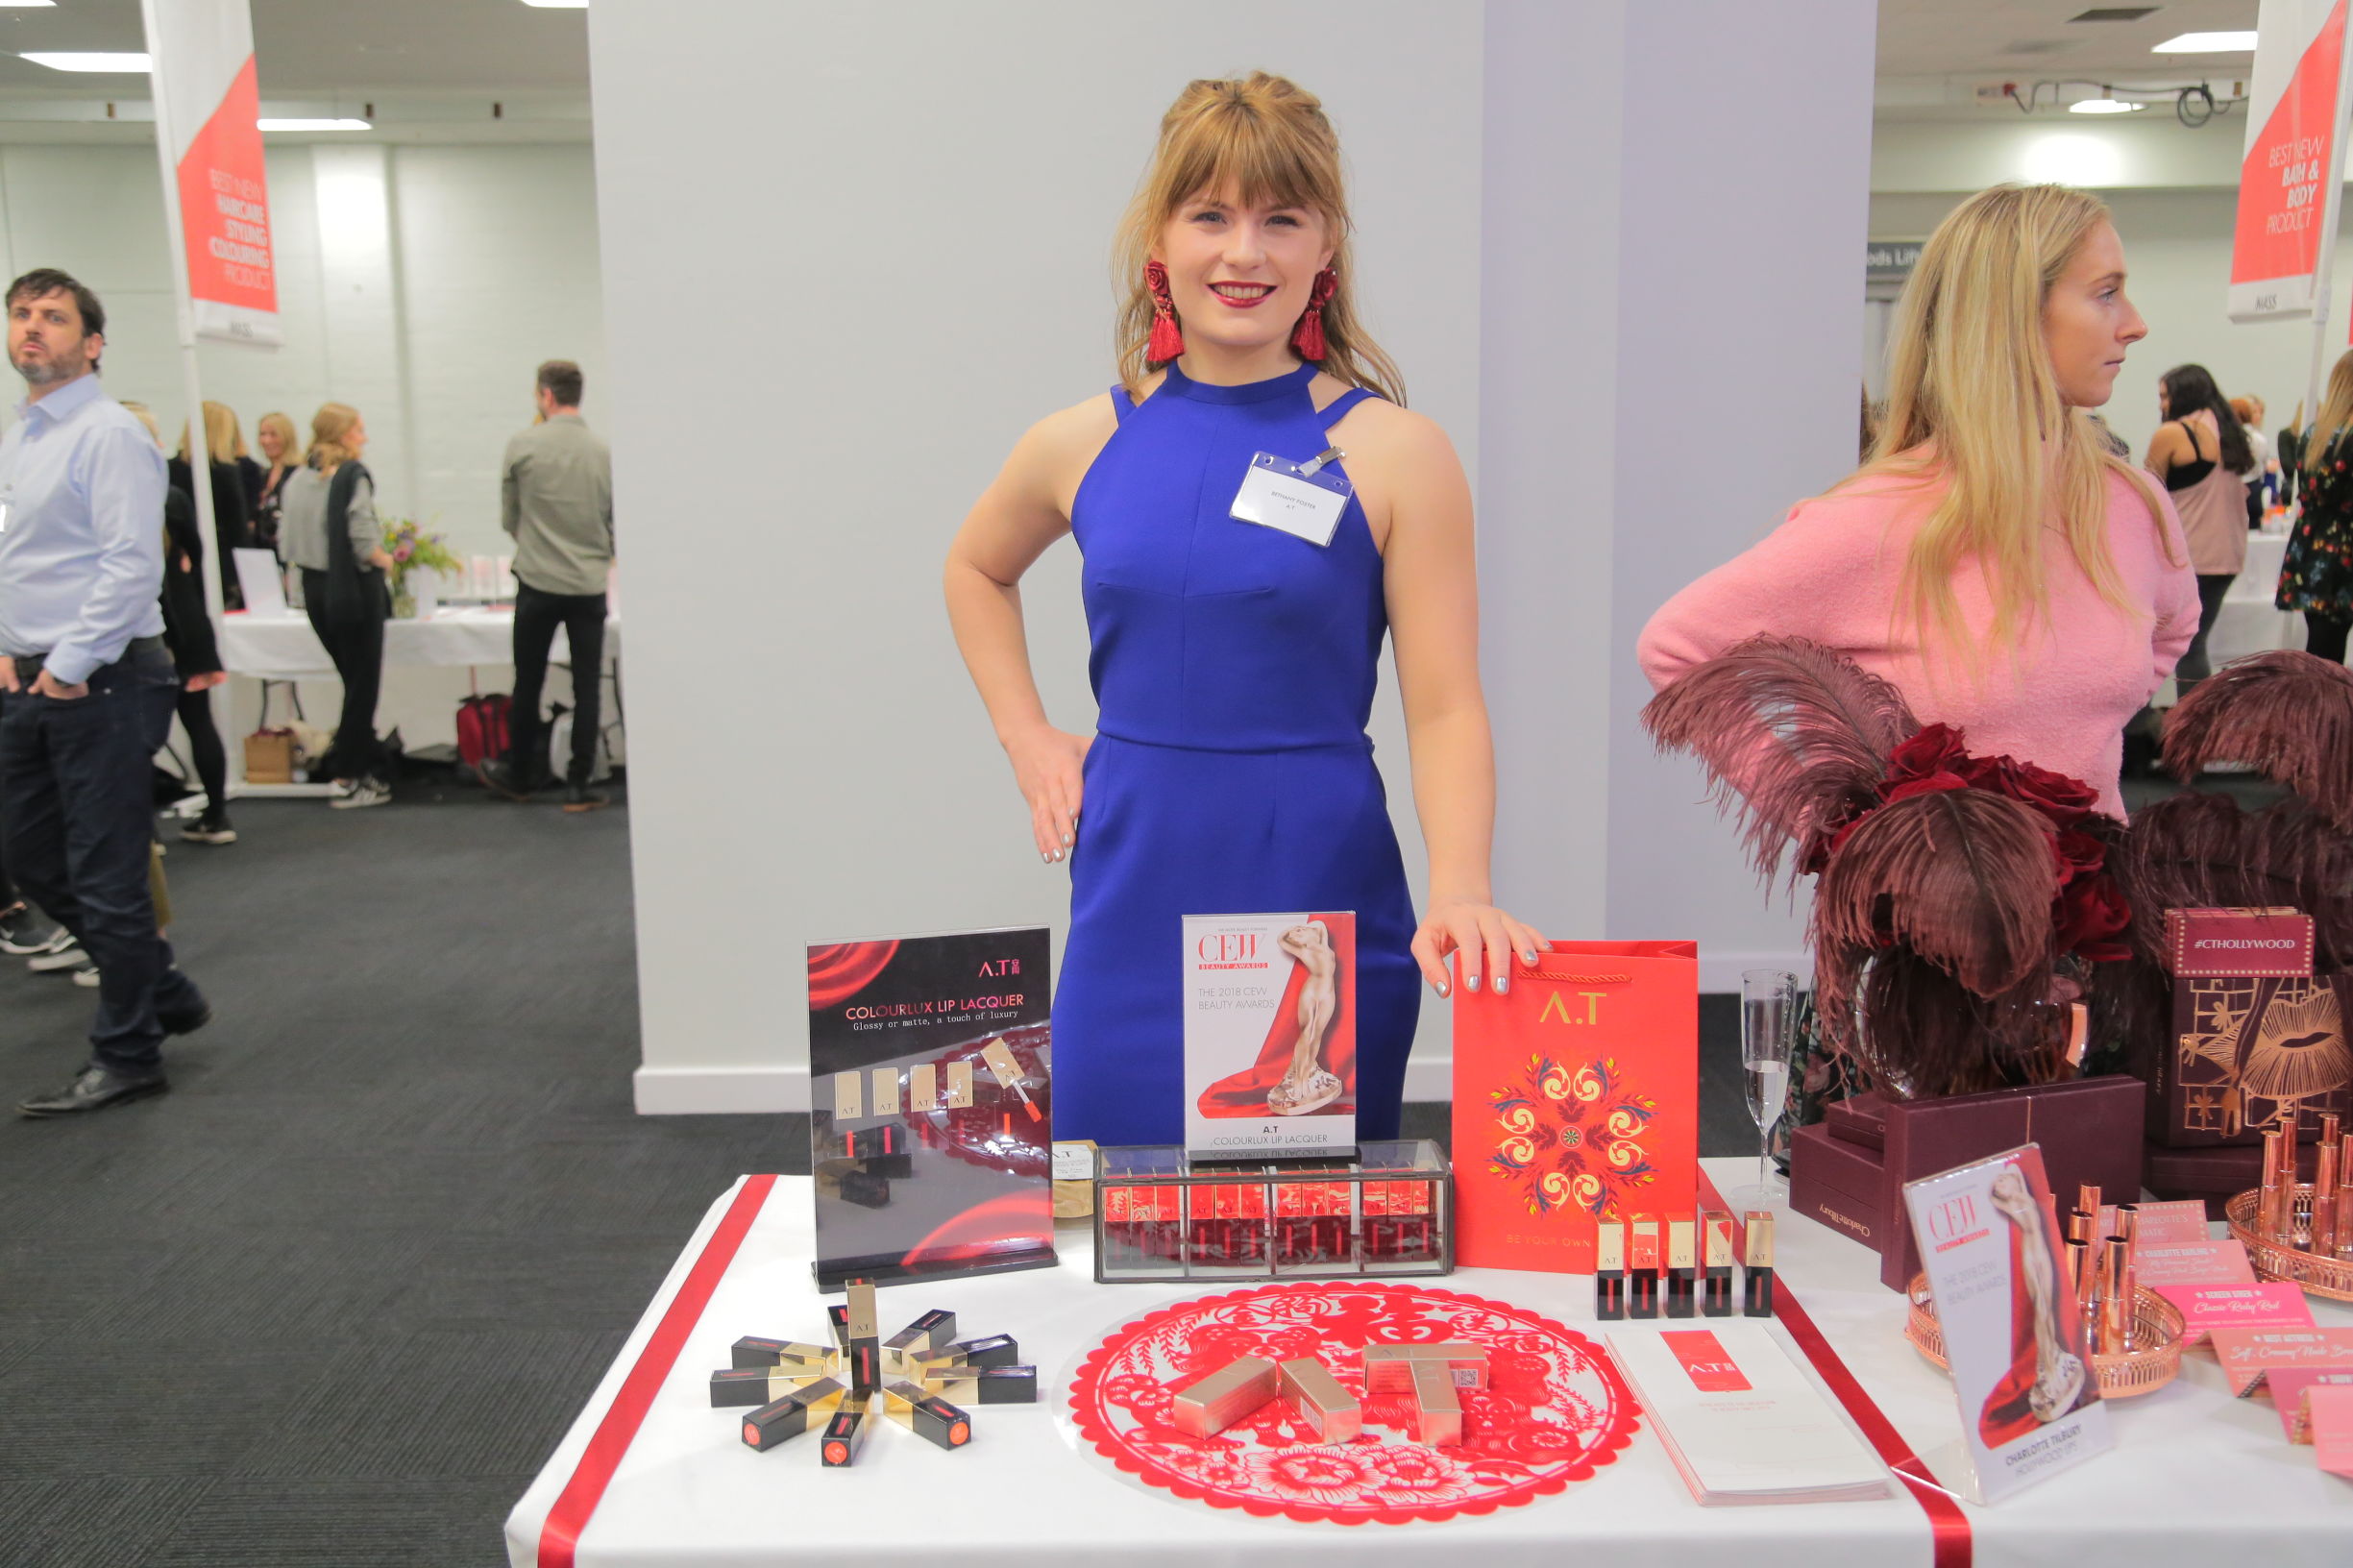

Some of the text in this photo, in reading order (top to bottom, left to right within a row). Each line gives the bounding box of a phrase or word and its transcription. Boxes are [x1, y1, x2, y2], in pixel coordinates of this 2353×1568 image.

[2268, 135, 2325, 168] BEST NEW
[2308, 159, 2319, 181] &
[2287, 184, 2317, 208] BODY
[2267, 208, 2315, 235] PRODUCT
[225, 218, 268, 247] STYLING
[1867, 249, 1892, 266] ods
[1271, 491, 1316, 510] BETHANY FOSTER
[1198, 934, 1266, 962] CEW
[2194, 939, 2295, 949] #CTHOLLYWOOD
[1199, 987, 1267, 996] THE 2018 CEW
[846, 993, 1024, 1020] COLOURLUX LIP LACQUER
[1199, 998, 1276, 1010] BEAUTY AWARDS
[853, 1020, 884, 1031] Glossy
[902, 1017, 930, 1027] matte,
[947, 1013, 970, 1023] touch
[991, 1010, 1018, 1020] luxury
[1262, 1125, 1279, 1134] A.T
[1213, 1135, 1328, 1146] COLOURLUX LIP LACQUER
[1928, 1195, 1977, 1241] CEW
[1506, 1234, 1591, 1248] BE YOUR OWN
[2005, 1424, 2082, 1466] CHARLOTTE TILBURY
